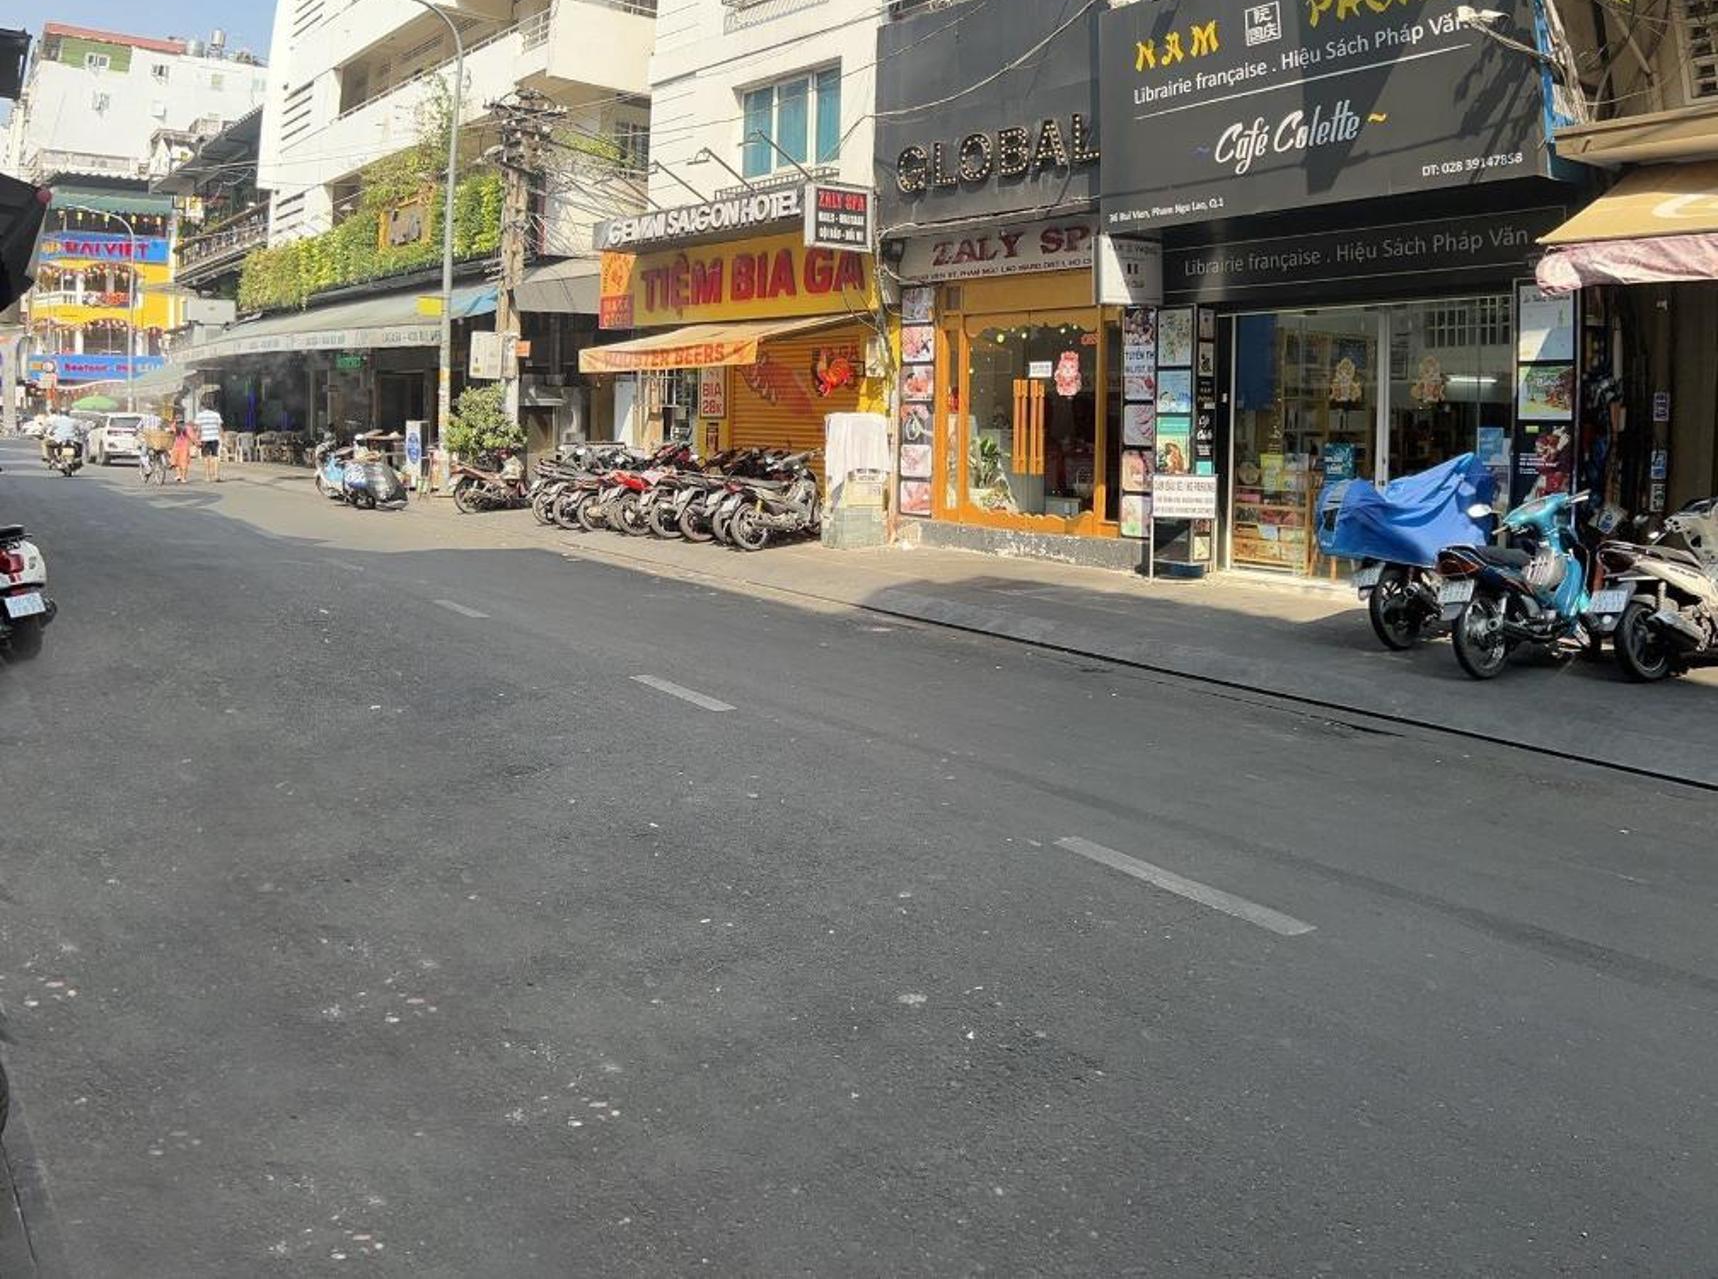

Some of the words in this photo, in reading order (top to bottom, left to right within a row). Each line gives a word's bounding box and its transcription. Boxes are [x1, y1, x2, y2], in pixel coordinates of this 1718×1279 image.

[1134, 78, 1192, 104] Librairie
[1196, 61, 1268, 87] française
[1282, 47, 1321, 70] Hiệu
[1325, 34, 1369, 60] Sách
[1375, 24, 1424, 48] Pháp
[1135, 19, 1219, 72] NAM
[897, 113, 1100, 193] GLOBAL
[1214, 117, 1271, 175] Café
[1273, 100, 1361, 152] Colette
[608, 213, 666, 246] GEMINI
[667, 201, 740, 234] SAIGON
[740, 190, 801, 223] HOTEL
[932, 230, 1025, 267] ZALY
[1040, 224, 1100, 254] SP
[1185, 257, 1243, 277] Librairie
[1249, 248, 1321, 271] française
[1337, 242, 1377, 263] Hiệu
[1383, 236, 1426, 257] Sách
[1434, 230, 1483, 253] Pháp
[1489, 224, 1528, 247] Văn
[641, 254, 723, 317] TIỆM
[731, 248, 797, 300] BIA
